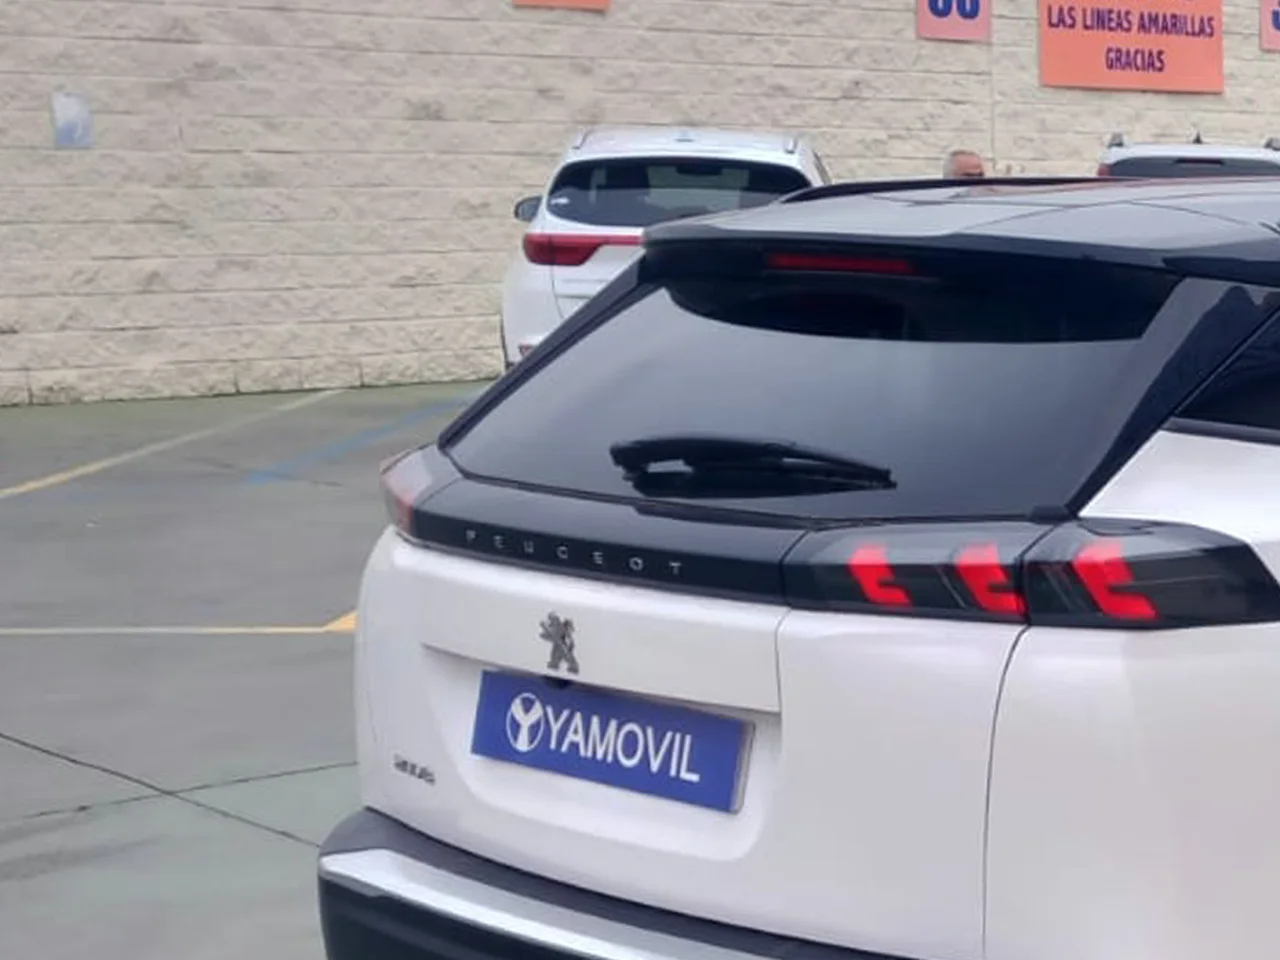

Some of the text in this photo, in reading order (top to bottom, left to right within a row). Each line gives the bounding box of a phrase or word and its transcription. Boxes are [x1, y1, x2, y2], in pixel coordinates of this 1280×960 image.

[1047, 5, 1214, 38] LAS LINEAS AMARILLAS
[1105, 47, 1165, 72] GRACIAS
[465, 528, 682, 577] PEUGEOT
[544, 702, 701, 784] YAMOVIL
